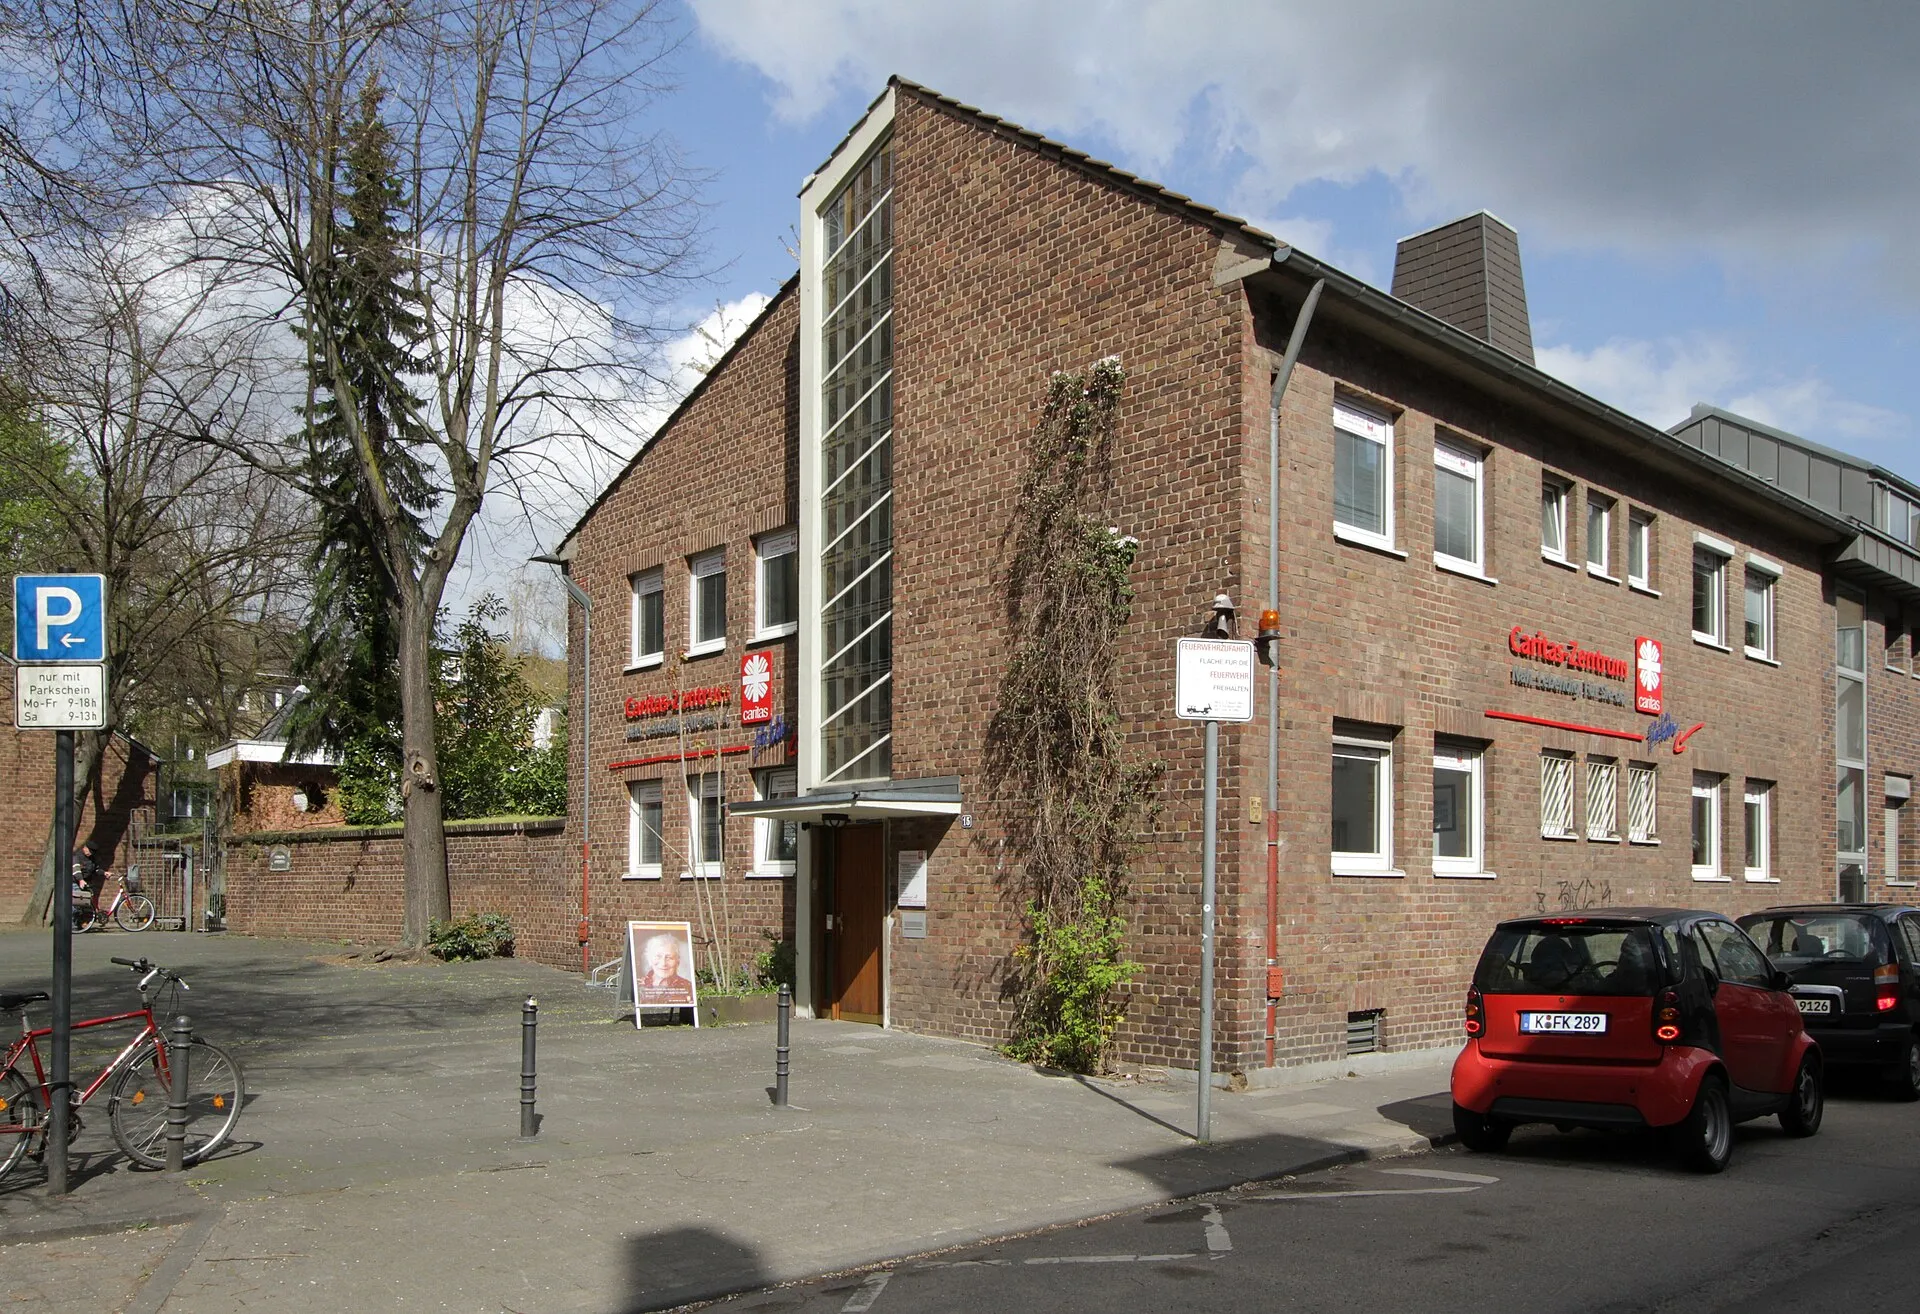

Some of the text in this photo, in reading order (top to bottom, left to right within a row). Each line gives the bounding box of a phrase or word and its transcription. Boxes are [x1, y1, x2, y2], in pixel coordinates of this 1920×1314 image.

[36, 587, 82, 650] P
[1181, 643, 1249, 653] FEUERWEHRZUFAHRT
[39, 672, 81, 682] nur mit
[1209, 671, 1249, 680] FEUERWEHR
[29, 685, 91, 695] Parkschein
[23, 698, 97, 708] Mo-Fr 9-18h
[1638, 695, 1661, 711] caritas
[24, 711, 97, 722] Sa 9-13h
[743, 706, 769, 720] caritas
[1800, 1001, 1829, 1012] 9126
[1535, 1016, 1600, 1029] K FK 289
